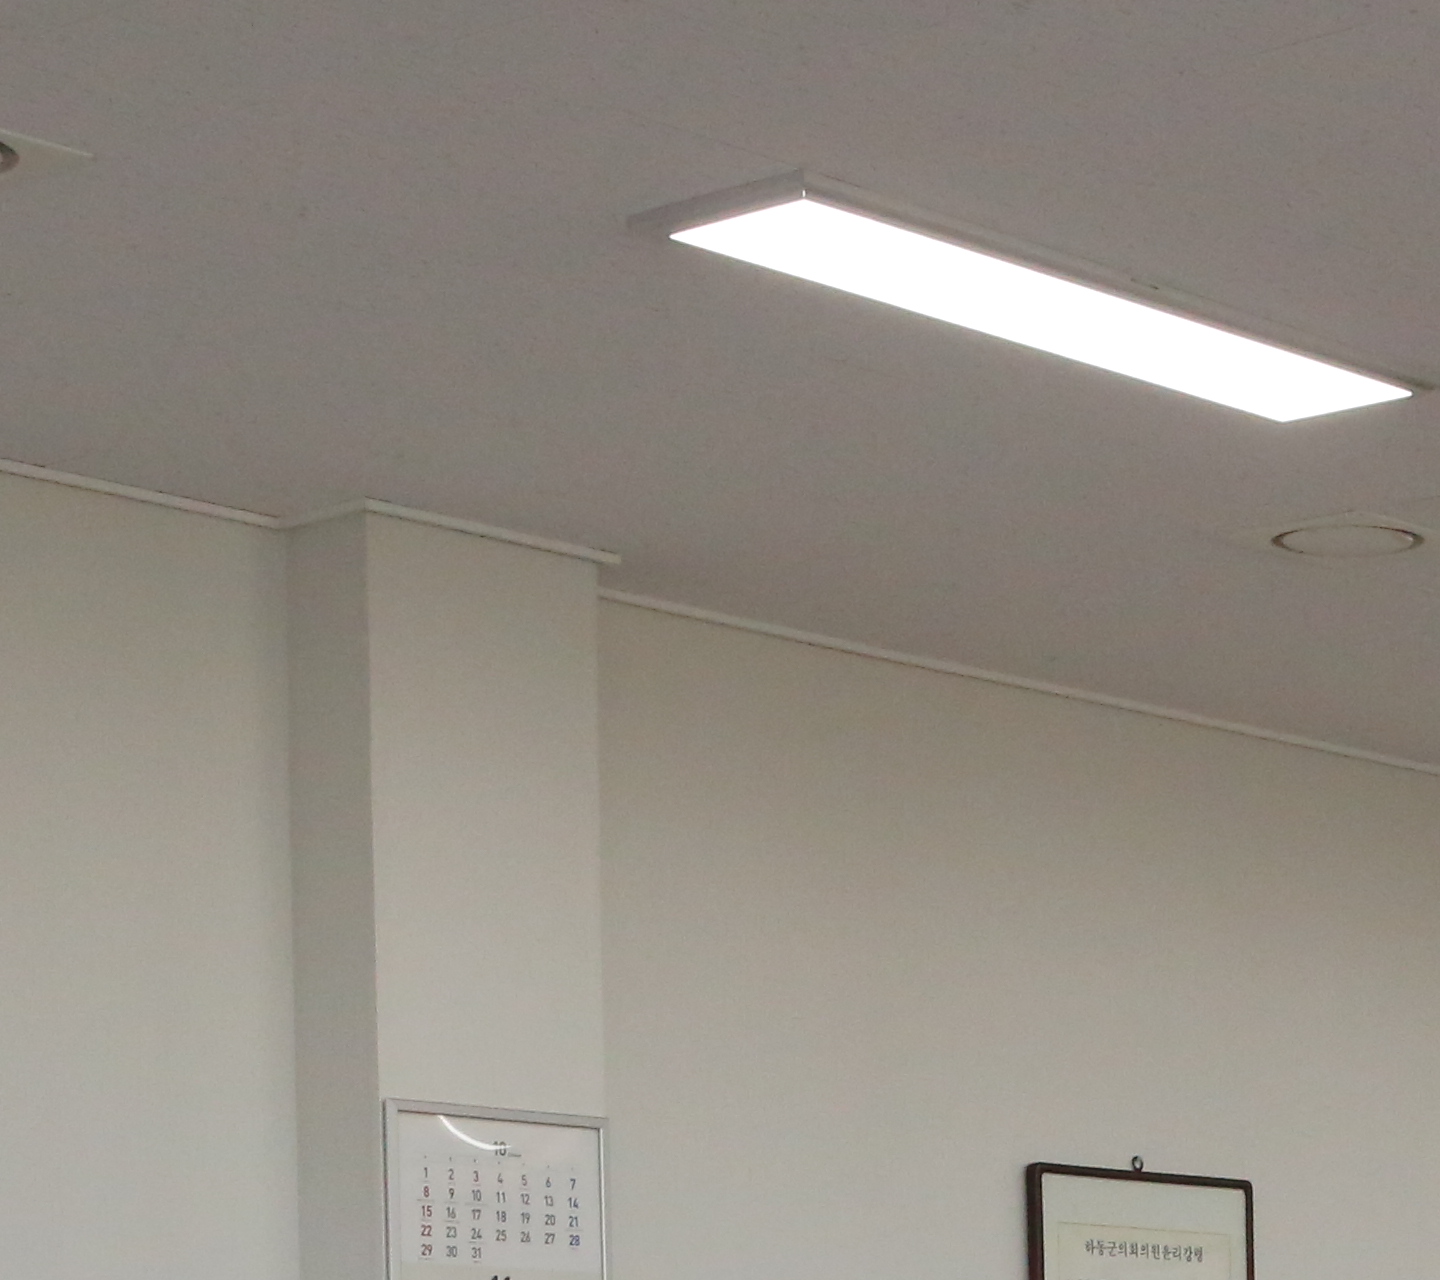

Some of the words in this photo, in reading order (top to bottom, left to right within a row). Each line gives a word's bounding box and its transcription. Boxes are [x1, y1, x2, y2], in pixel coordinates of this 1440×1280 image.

[472, 1189, 482, 1202] 10
[496, 1191, 506, 1203] 11
[520, 1193, 530, 1205] 12
[544, 1195, 554, 1207] 13
[568, 1197, 579, 1209] 14
[422, 1205, 432, 1217] 15
[446, 1206, 456, 1219] 16
[471, 1209, 481, 1220] 17
[496, 1210, 506, 1223] 18
[520, 1212, 530, 1224] 19
[545, 1214, 556, 1226] 20
[569, 1215, 578, 1227] 21
[421, 1224, 432, 1237] 22
[446, 1226, 457, 1238] 23
[471, 1228, 482, 1240] 24
[496, 1229, 507, 1242] 25
[520, 1231, 531, 1243] 26
[544, 1232, 555, 1245] 27
[569, 1234, 580, 1246] 28
[421, 1243, 433, 1256] 29
[446, 1245, 458, 1258] 30
[471, 1247, 481, 1259] 31
